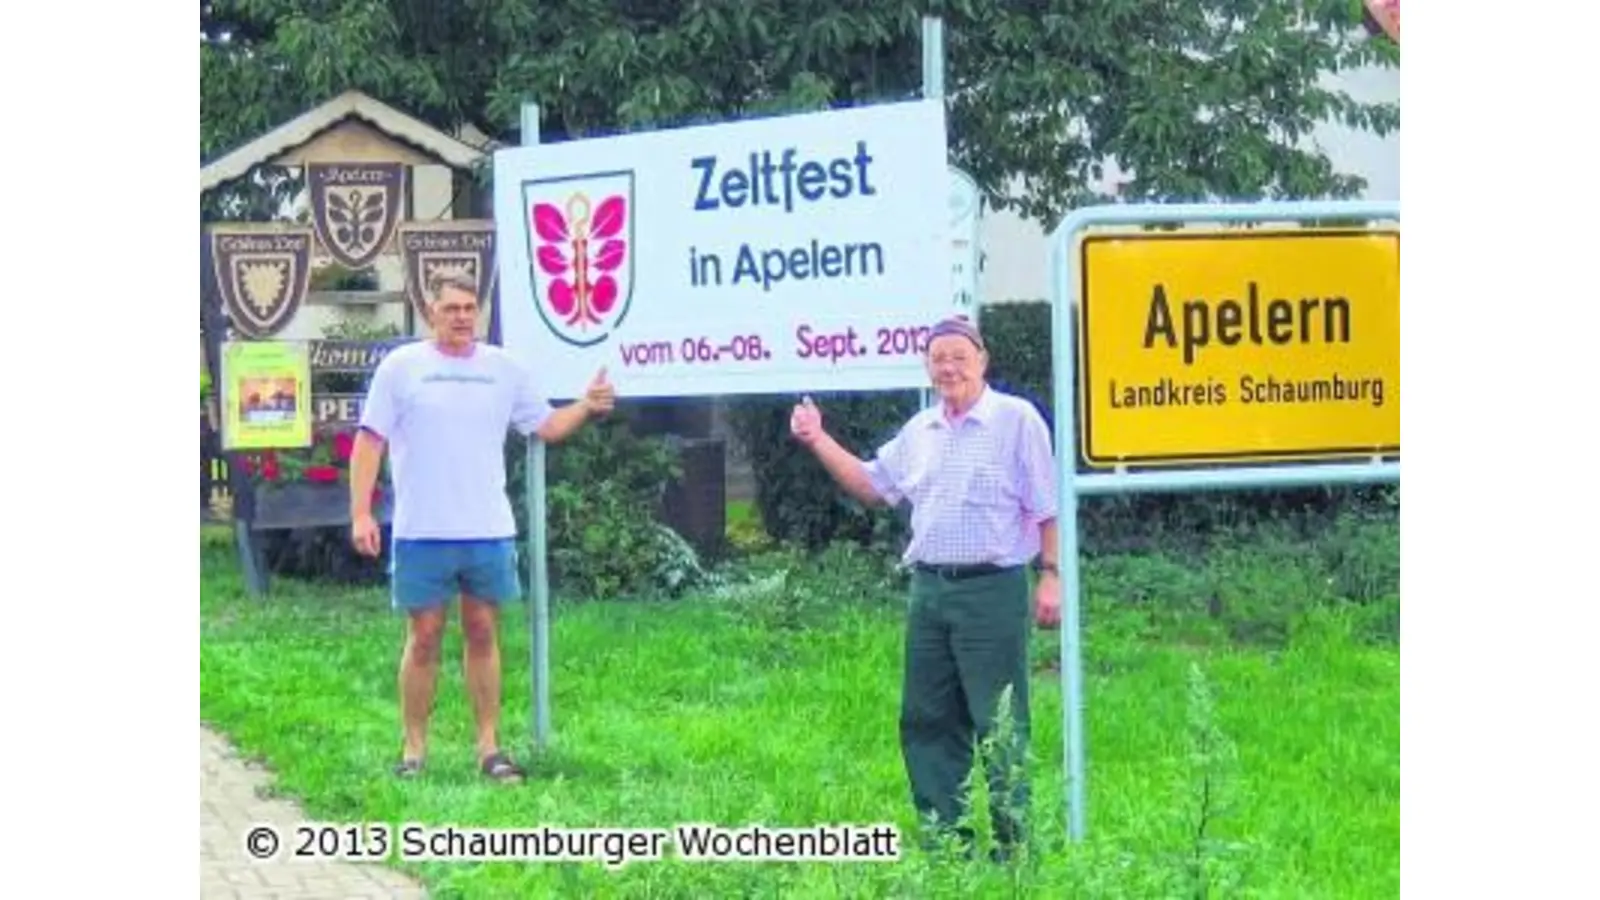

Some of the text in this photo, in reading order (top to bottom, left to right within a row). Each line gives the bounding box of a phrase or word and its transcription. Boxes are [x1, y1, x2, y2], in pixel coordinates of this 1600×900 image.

[690, 140, 876, 213] Zeltfest
[689, 239, 884, 291] in Apelern
[620, 340, 674, 366] vom
[796, 324, 868, 364] Sept.
[1142, 281, 1351, 366] Apelern
[1109, 372, 1385, 409] Landkreis Schaumburg
